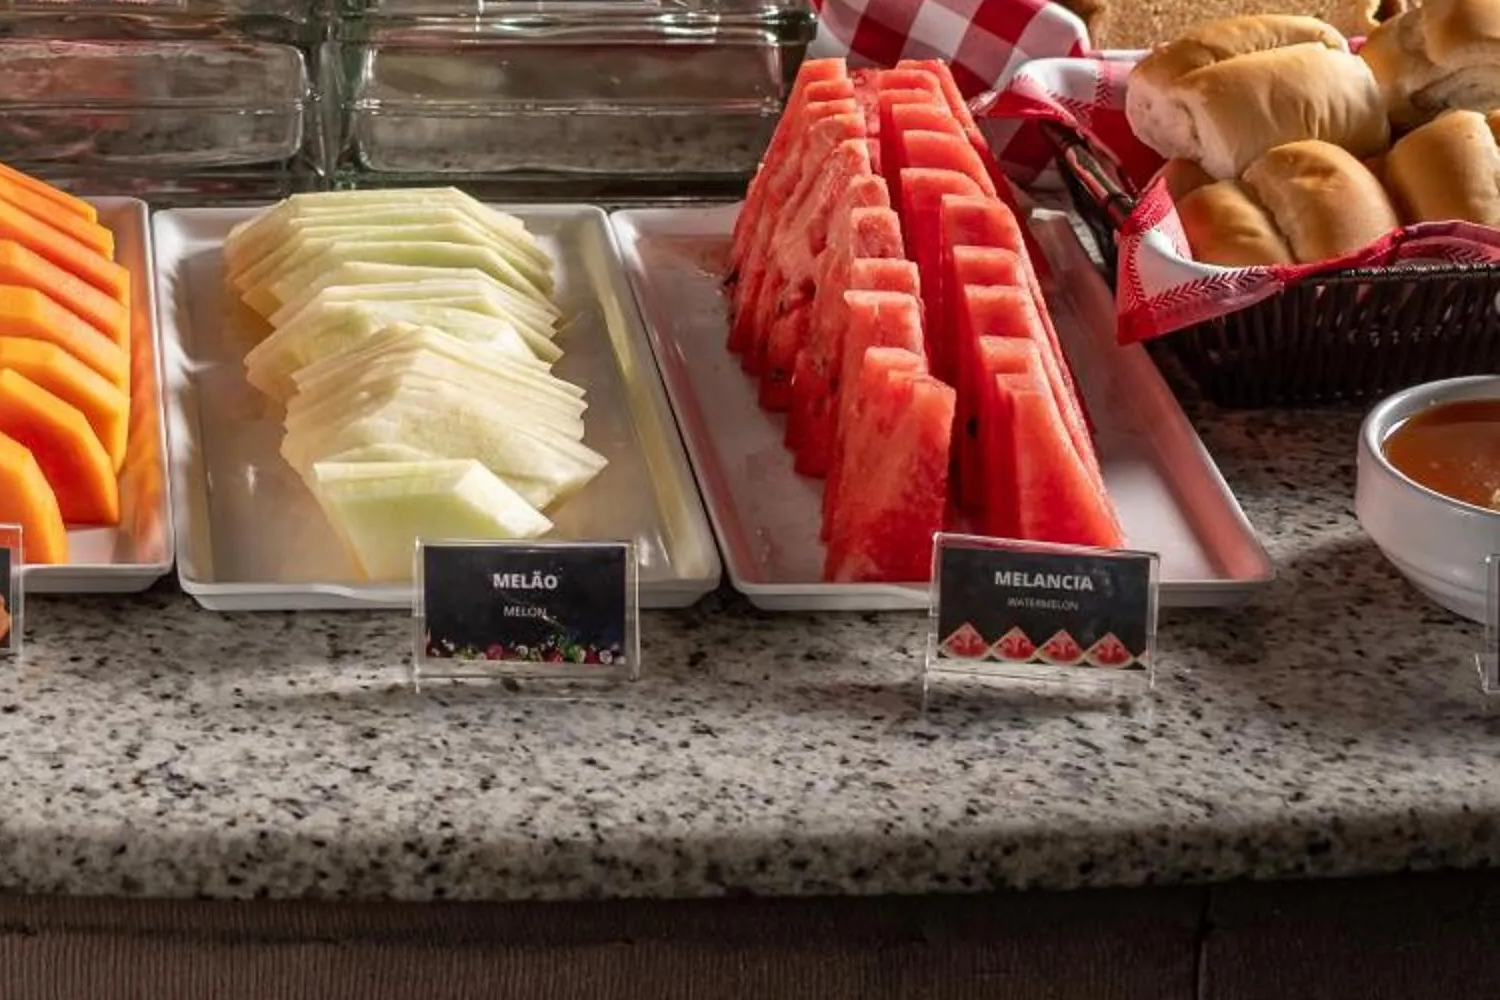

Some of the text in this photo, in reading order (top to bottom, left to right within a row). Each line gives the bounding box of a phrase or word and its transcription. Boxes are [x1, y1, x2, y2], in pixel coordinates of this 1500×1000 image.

[492, 570, 559, 589] MELÃO
[994, 571, 1094, 591] MELANCIA
[503, 605, 547, 618] MELON
